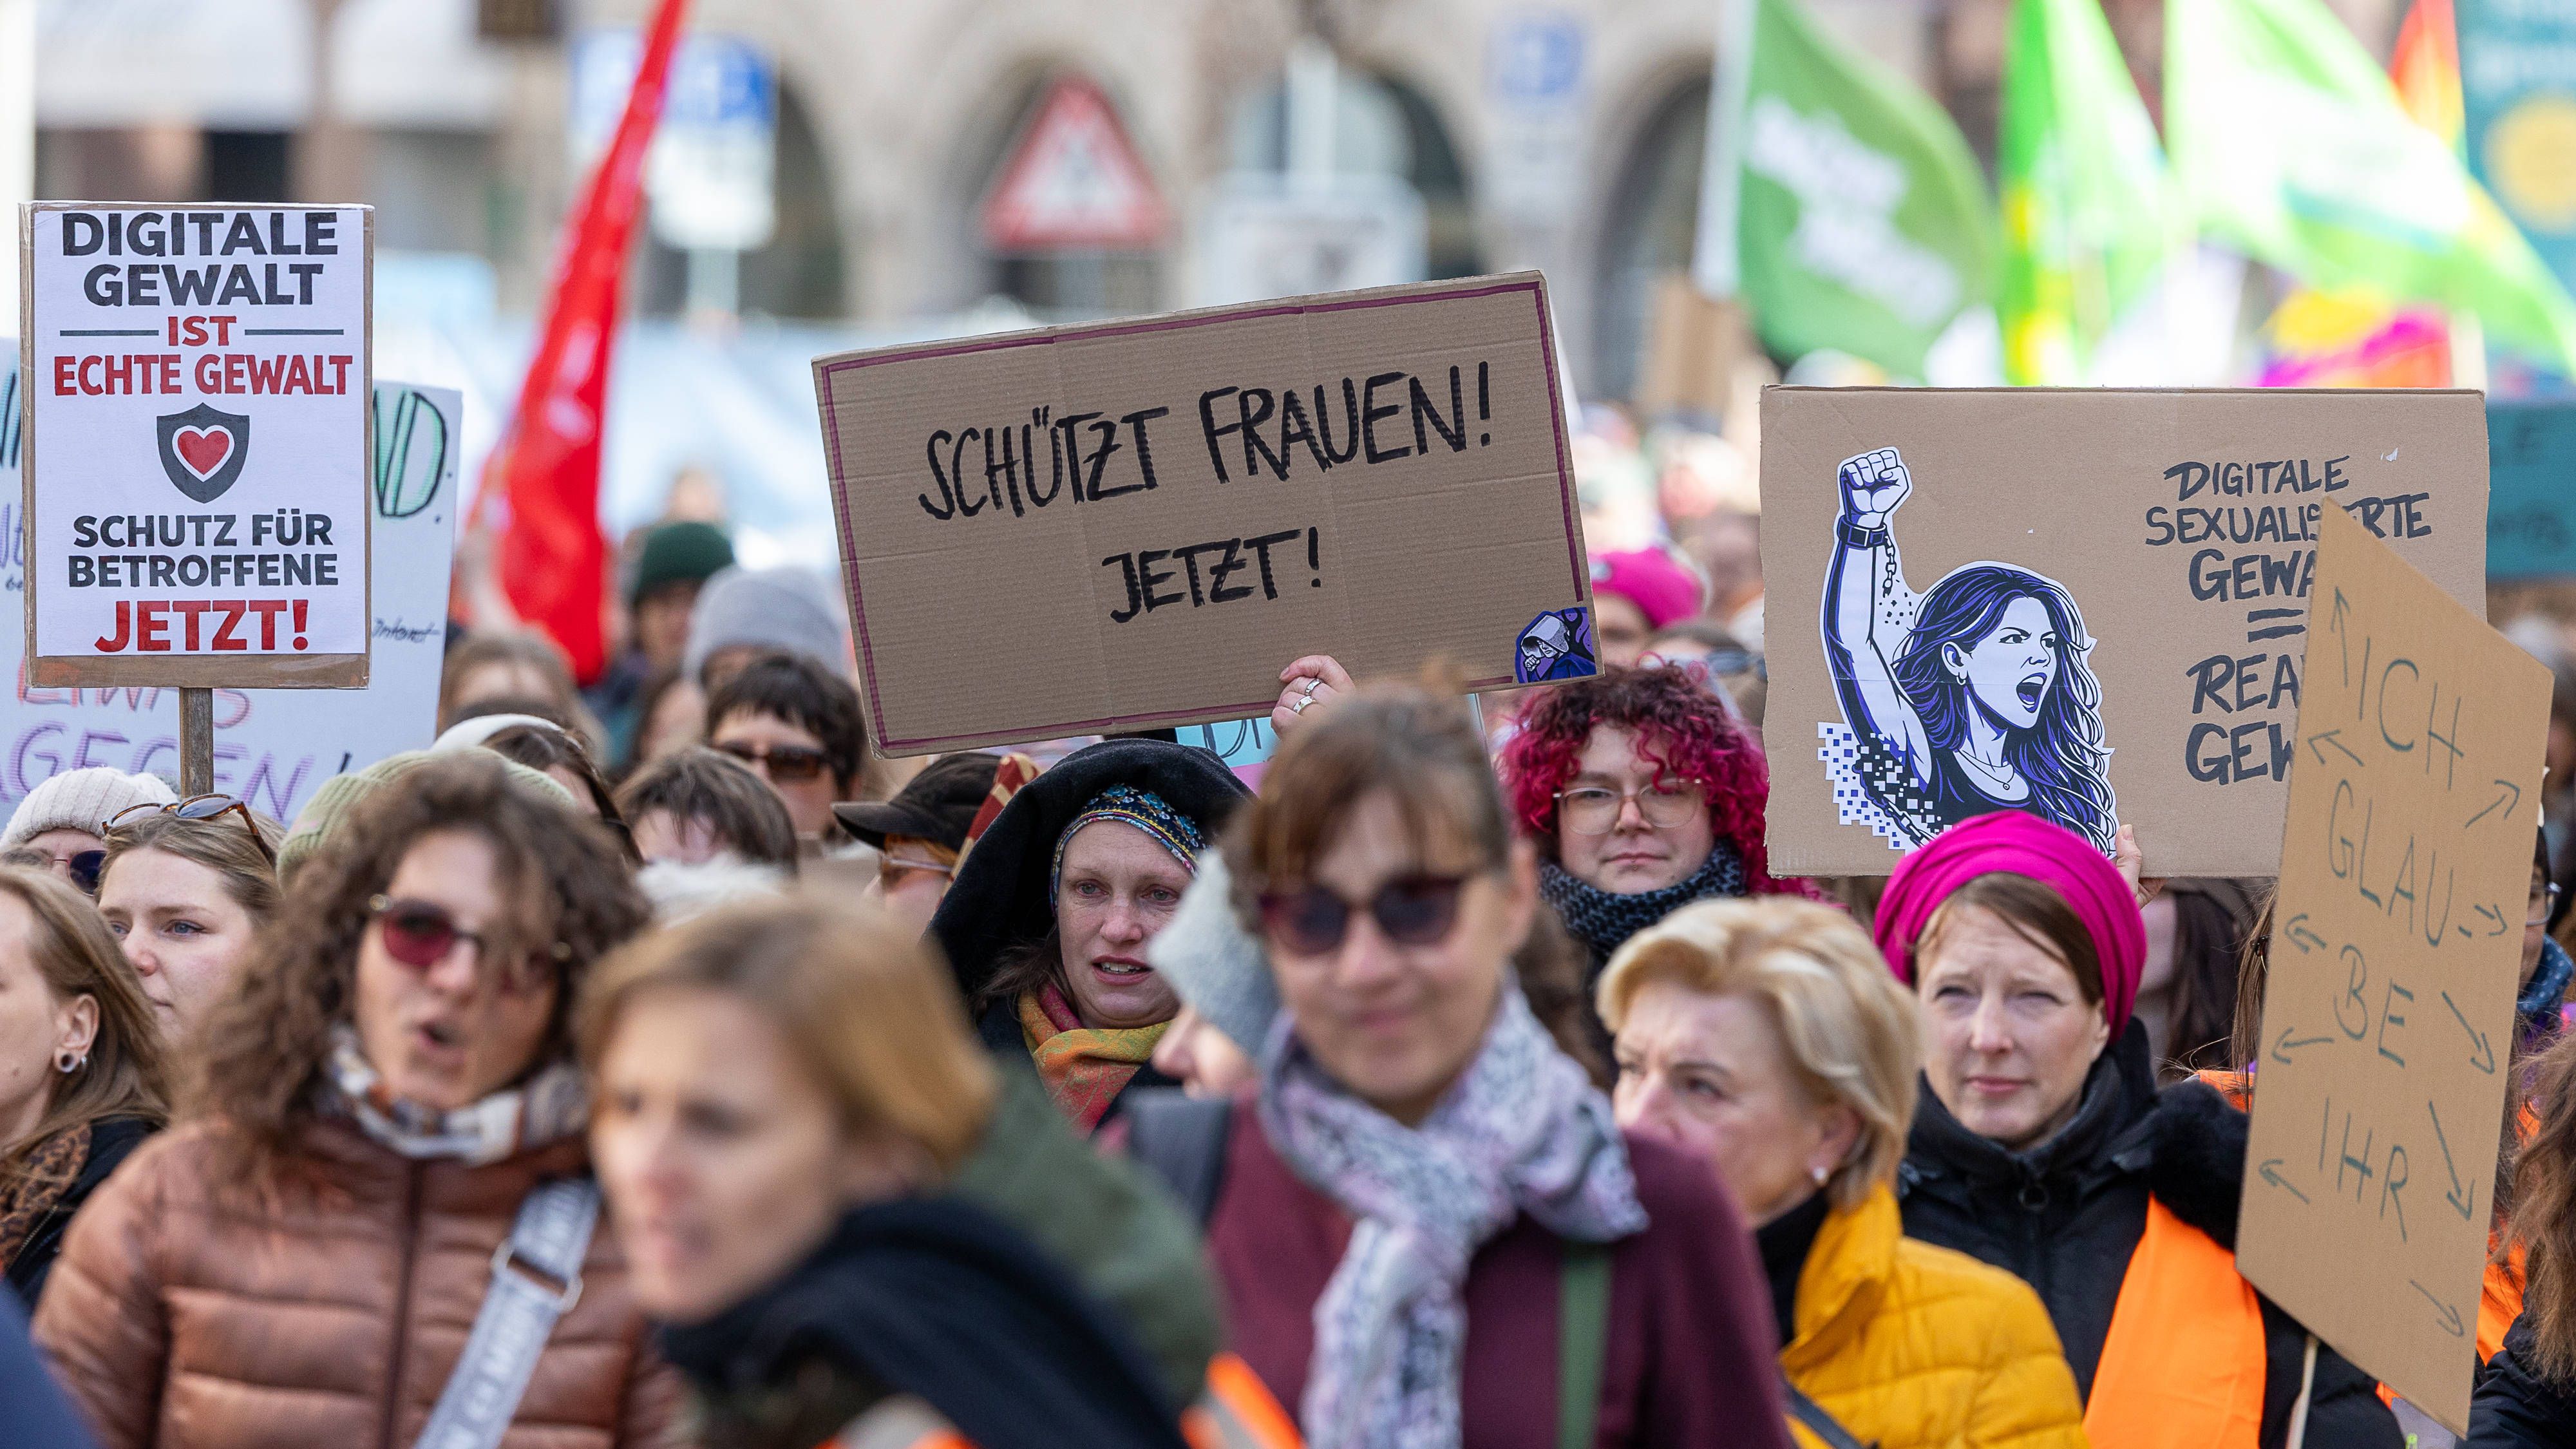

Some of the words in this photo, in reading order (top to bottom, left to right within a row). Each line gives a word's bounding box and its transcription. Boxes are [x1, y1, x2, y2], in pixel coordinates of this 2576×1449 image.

[62, 212, 338, 257] DIGITALE
[84, 263, 323, 307] GEWALT
[168, 316, 237, 346] IST
[54, 355, 182, 396] ECHTE
[194, 354, 353, 395] GEWALT
[918, 405, 1170, 520] SCHÜTZT
[1199, 361, 1490, 484] FRAUEN!
[2163, 455, 2350, 501] DIGITALE
[73, 515, 238, 548] SCHUTZ
[252, 508, 334, 547] FÜR
[69, 554, 339, 587] BETROFFENE
[1101, 527, 1321, 623] JETZT!
[94, 600, 308, 652] JETZT!
[2359, 637, 2465, 791] ICH
[2333, 943, 2414, 1068] BE
[2318, 1096, 2409, 1243] IHR
